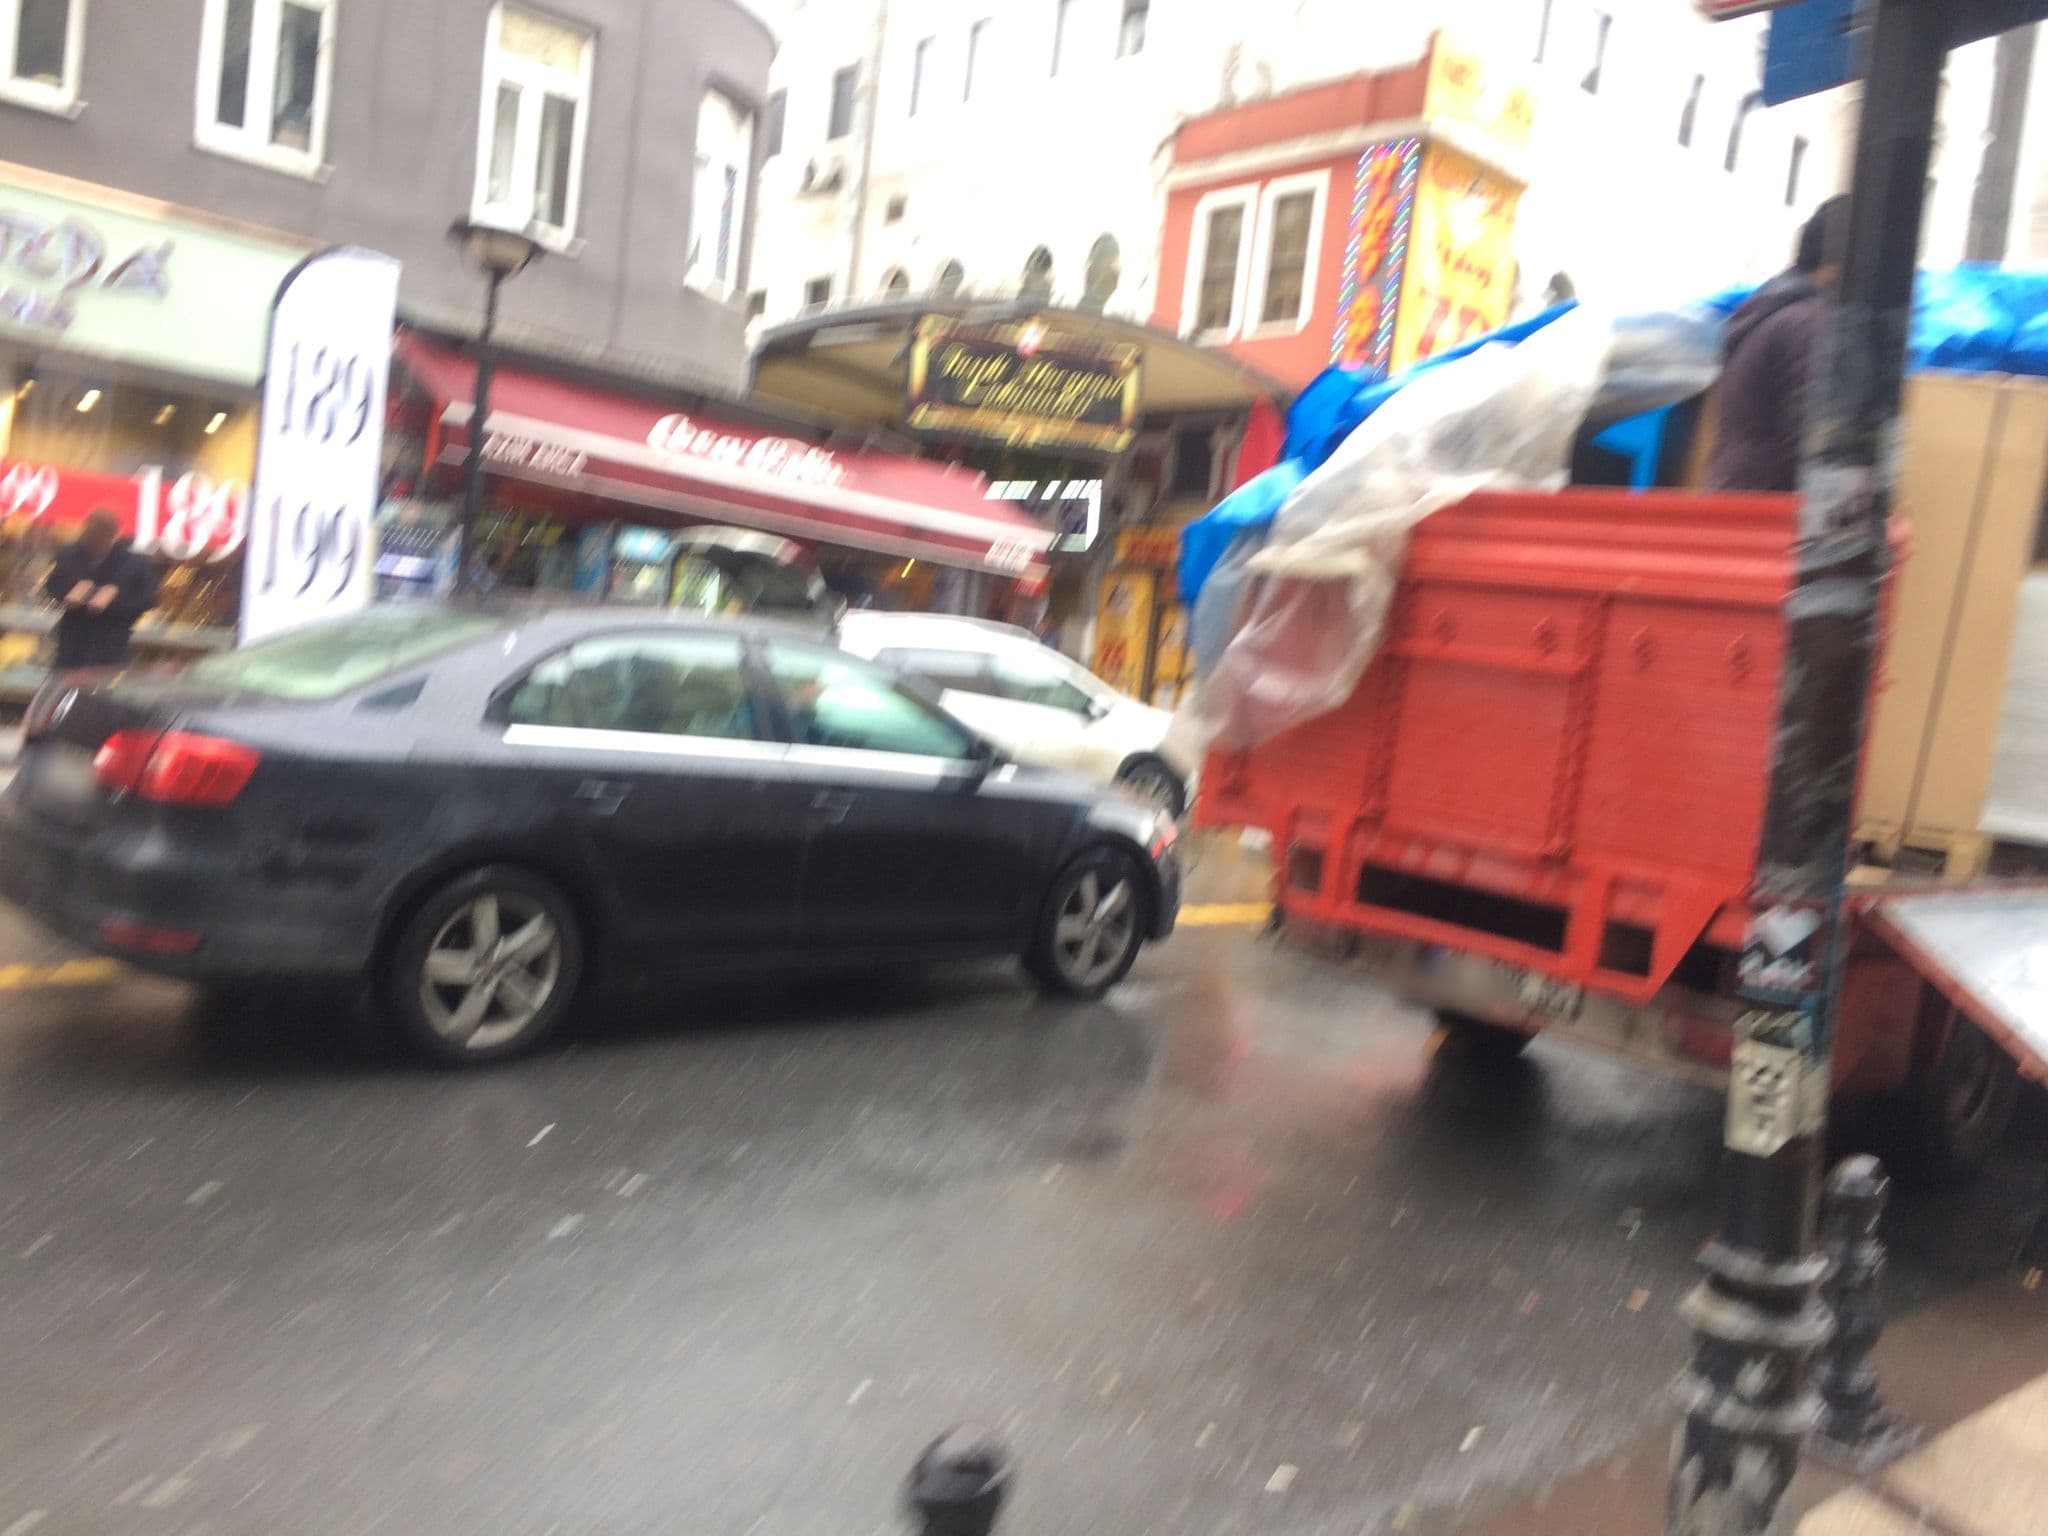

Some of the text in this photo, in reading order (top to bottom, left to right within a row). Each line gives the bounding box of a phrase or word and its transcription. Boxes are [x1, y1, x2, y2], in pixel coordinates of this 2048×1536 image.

[280, 341, 375, 446] 189
[128, 464, 250, 564] 189
[260, 496, 361, 603] 199
